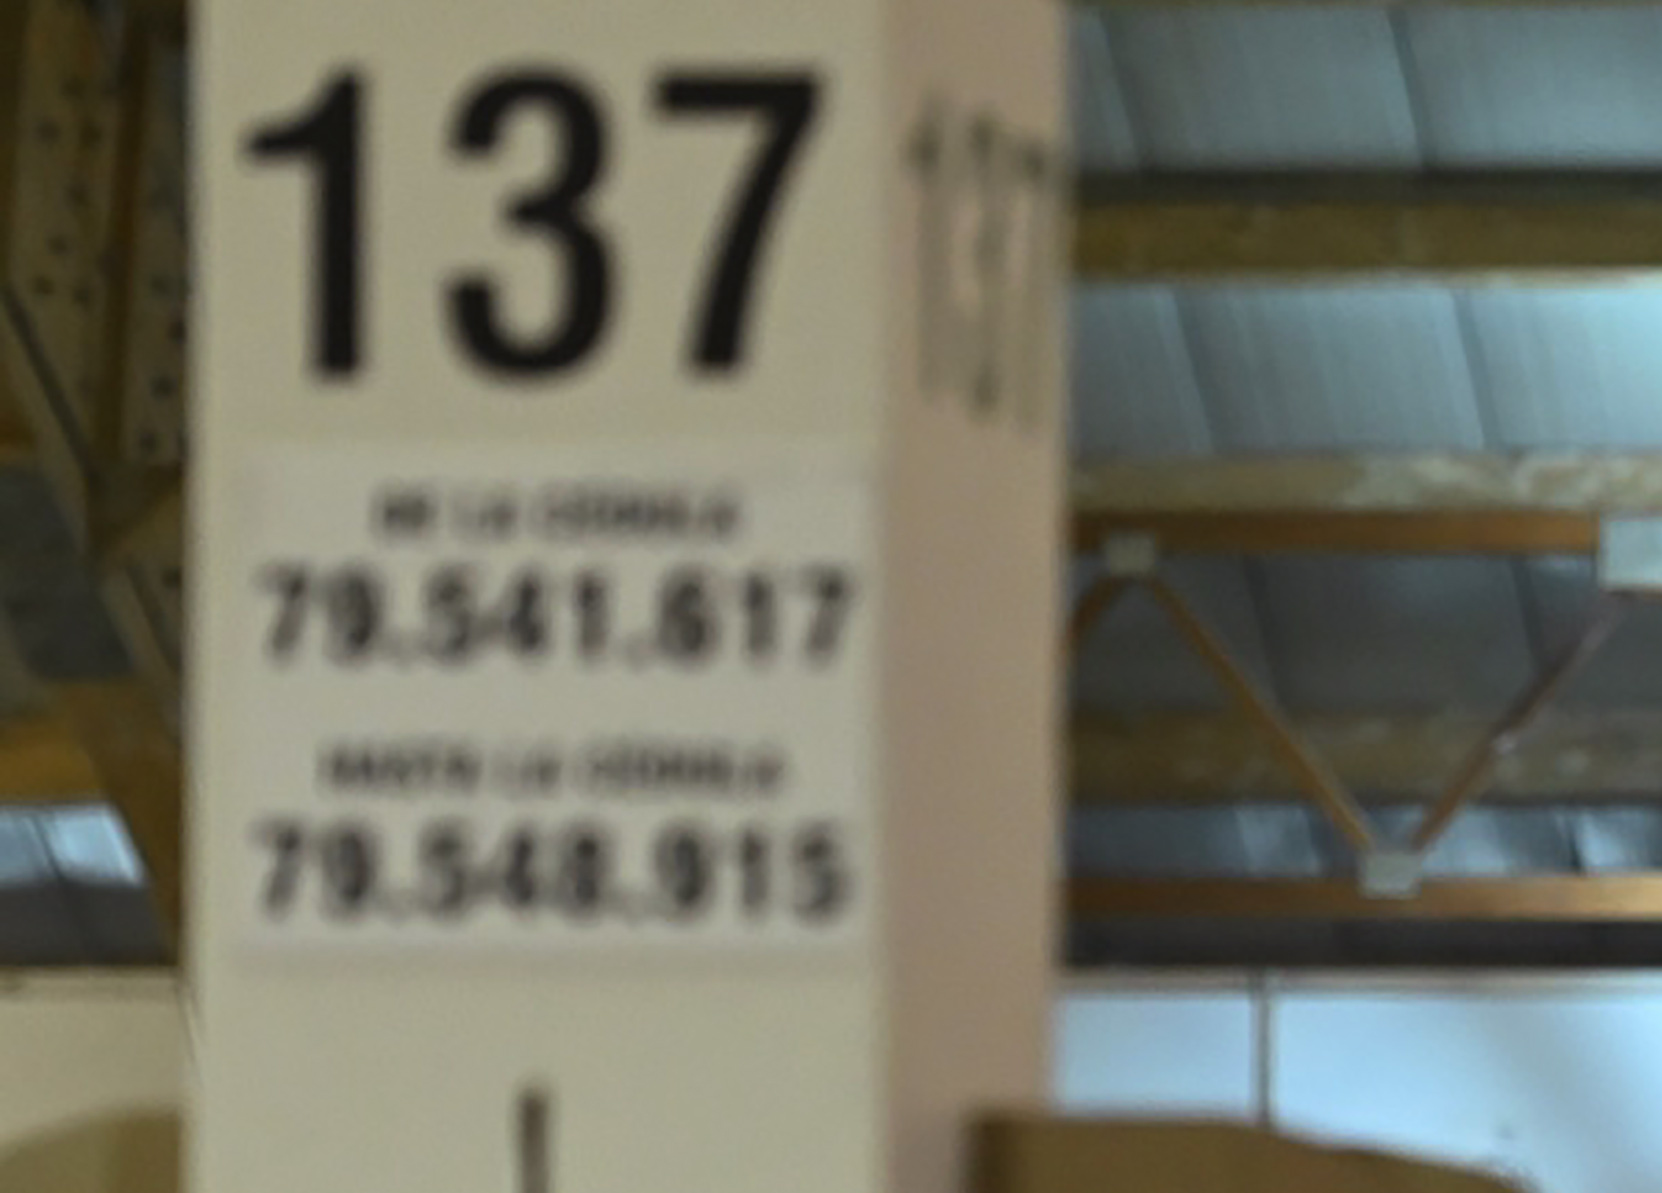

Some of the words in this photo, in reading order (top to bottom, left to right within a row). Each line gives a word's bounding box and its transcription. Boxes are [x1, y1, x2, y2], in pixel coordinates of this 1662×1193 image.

[242, 68, 826, 386] 137
[255, 562, 854, 670] 79.541.617
[250, 818, 852, 924] 79.548.915
